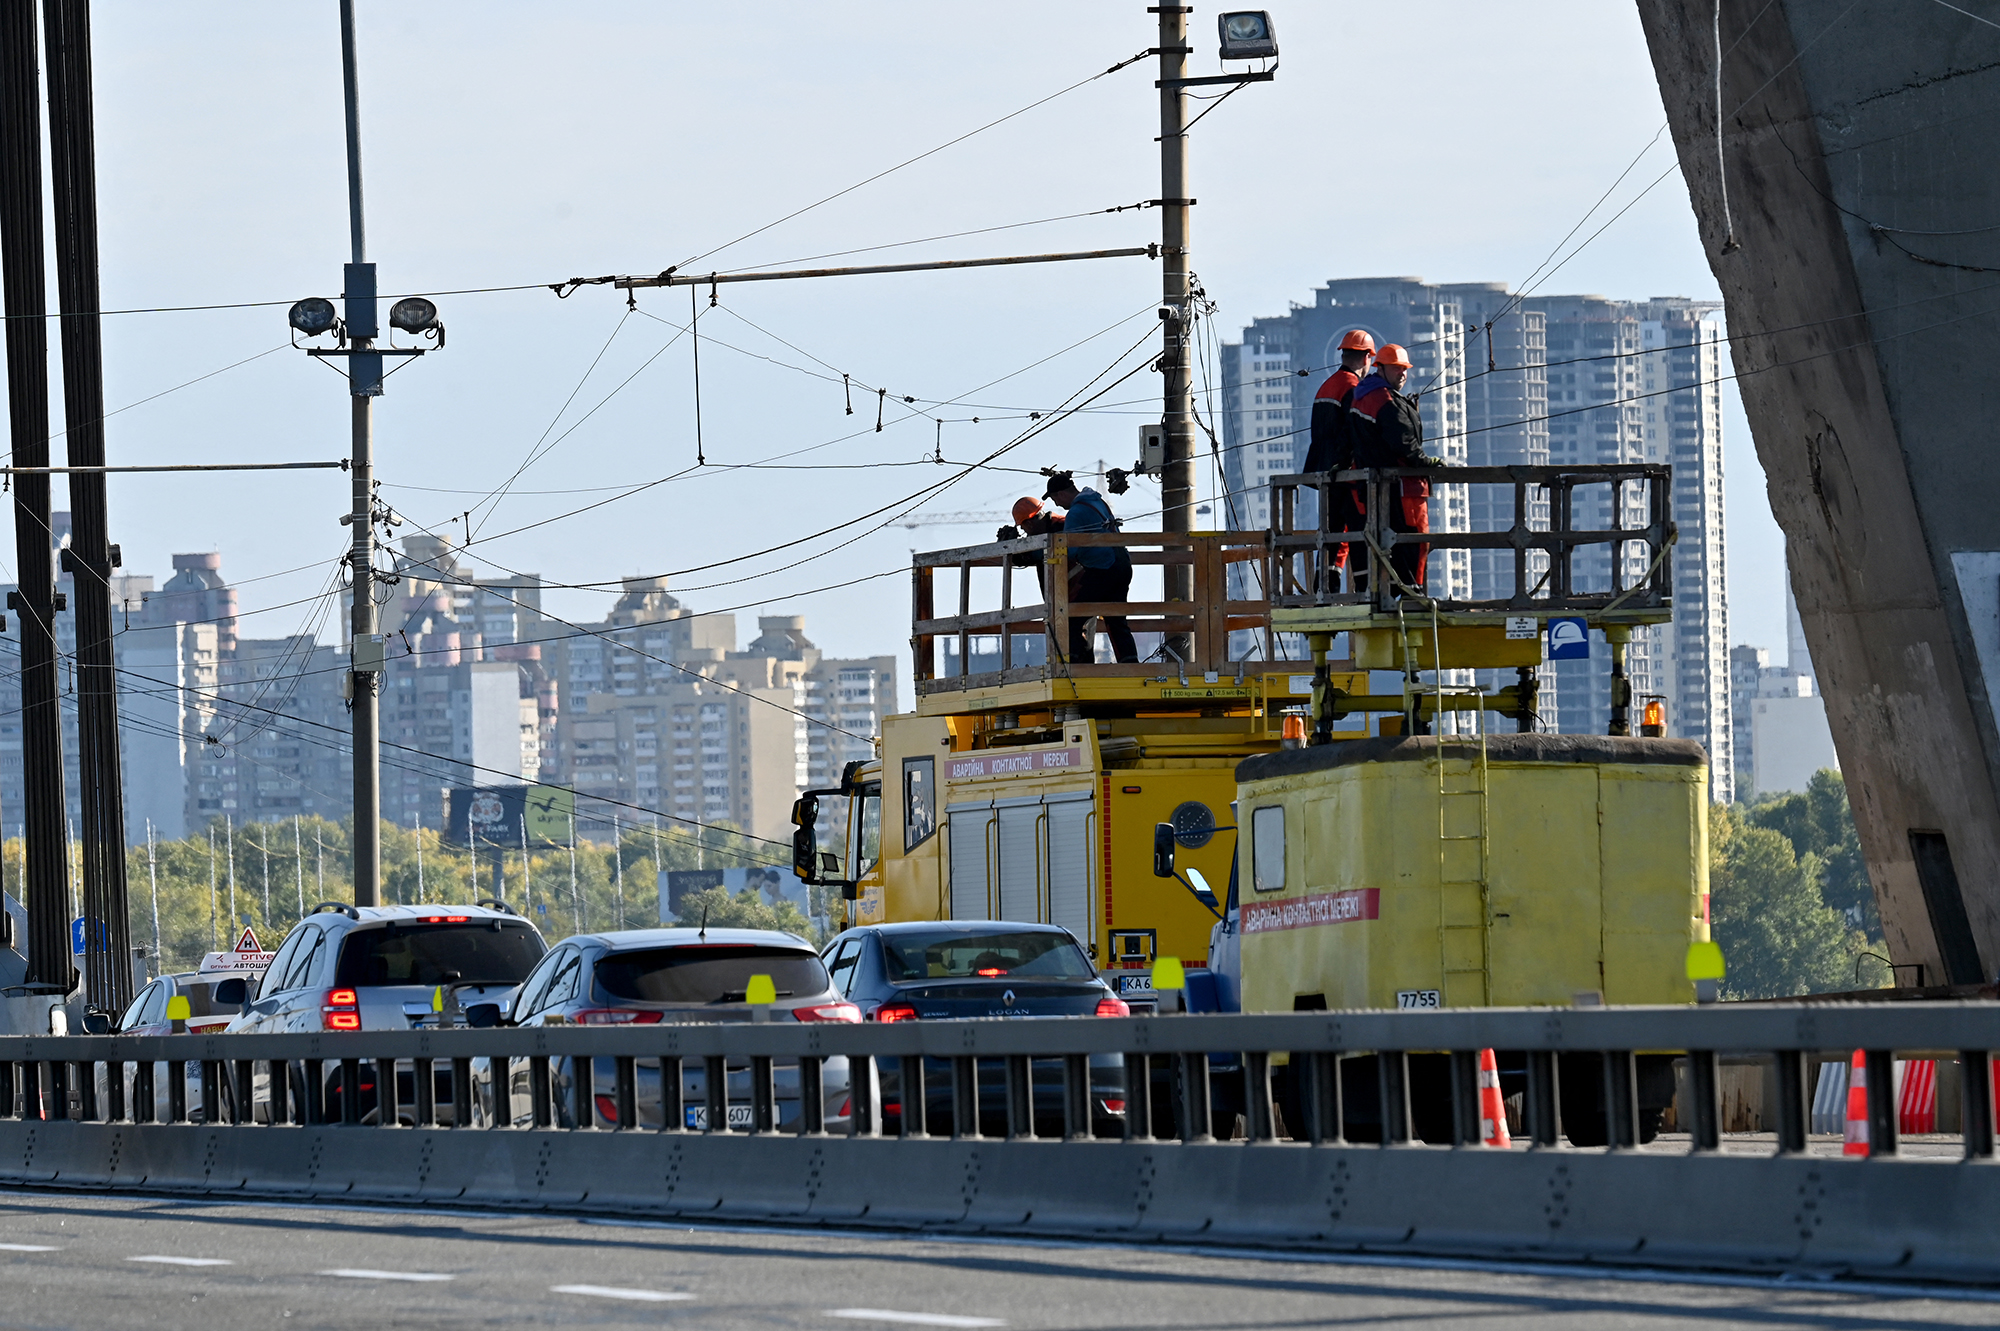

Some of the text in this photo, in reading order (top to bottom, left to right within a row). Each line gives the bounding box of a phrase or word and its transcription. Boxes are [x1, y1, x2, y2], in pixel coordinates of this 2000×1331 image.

[1184, 690, 1191, 698] kg
[952, 751, 1069, 778] АВАРІЙНА КОНТАКТНОЇ МЕРЕЖІ
[1245, 896, 1359, 931] АВАРІЙНА КОНТАКТНОЇ МЕРЕЖІ
[241, 953, 274, 961] Drive
[1126, 978, 1142, 990] KA
[1401, 992, 1436, 1008] 7755
[728, 1107, 753, 1122] 607
